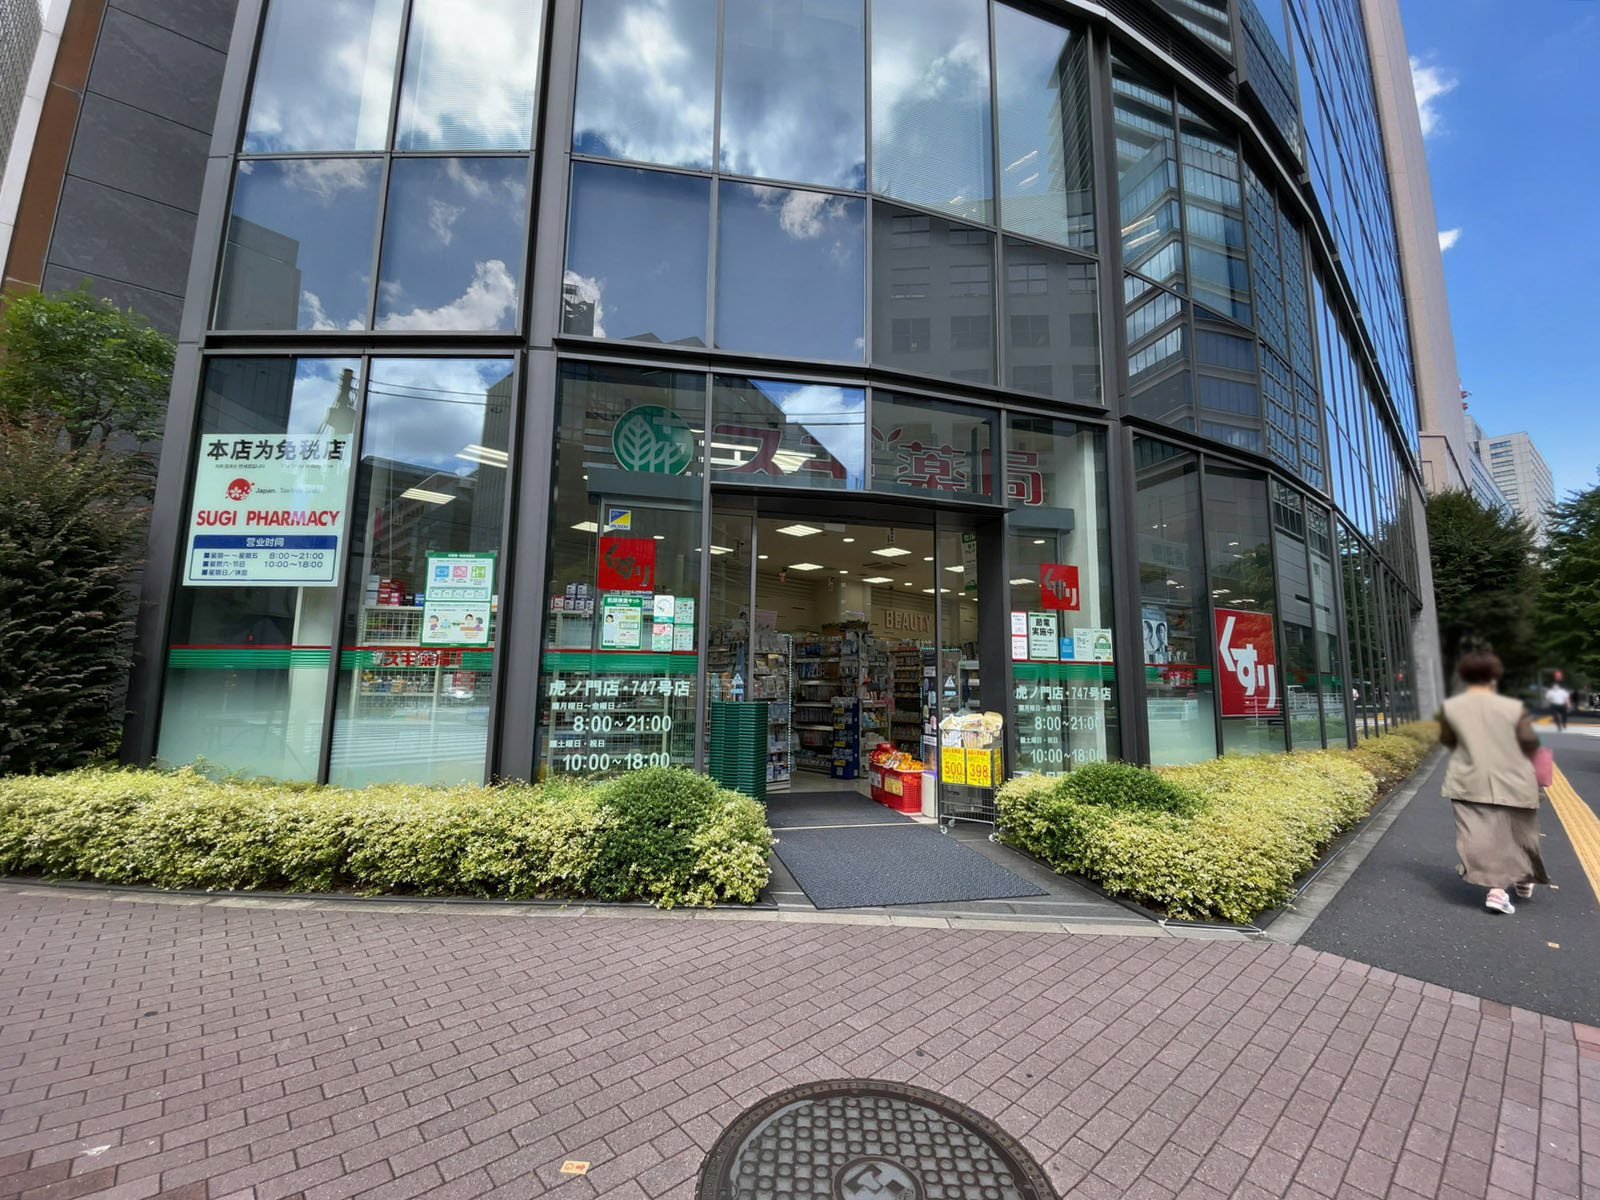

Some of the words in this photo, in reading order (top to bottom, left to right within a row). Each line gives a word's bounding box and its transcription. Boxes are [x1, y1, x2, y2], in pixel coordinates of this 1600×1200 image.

[207, 439, 346, 461] 本店为免税店
[196, 510, 237, 526] SUGI
[246, 510, 340, 526] PHARMACY
[246, 537, 284, 548] 营业时间
[604, 543, 650, 587] くすり
[1044, 568, 1077, 606] くすり
[884, 609, 930, 633] BEAUTY
[1031, 627, 1054, 636] 実施中
[1219, 616, 1276, 708] くすり
[945, 761, 963, 775] 500
[969, 763, 988, 778] 398
